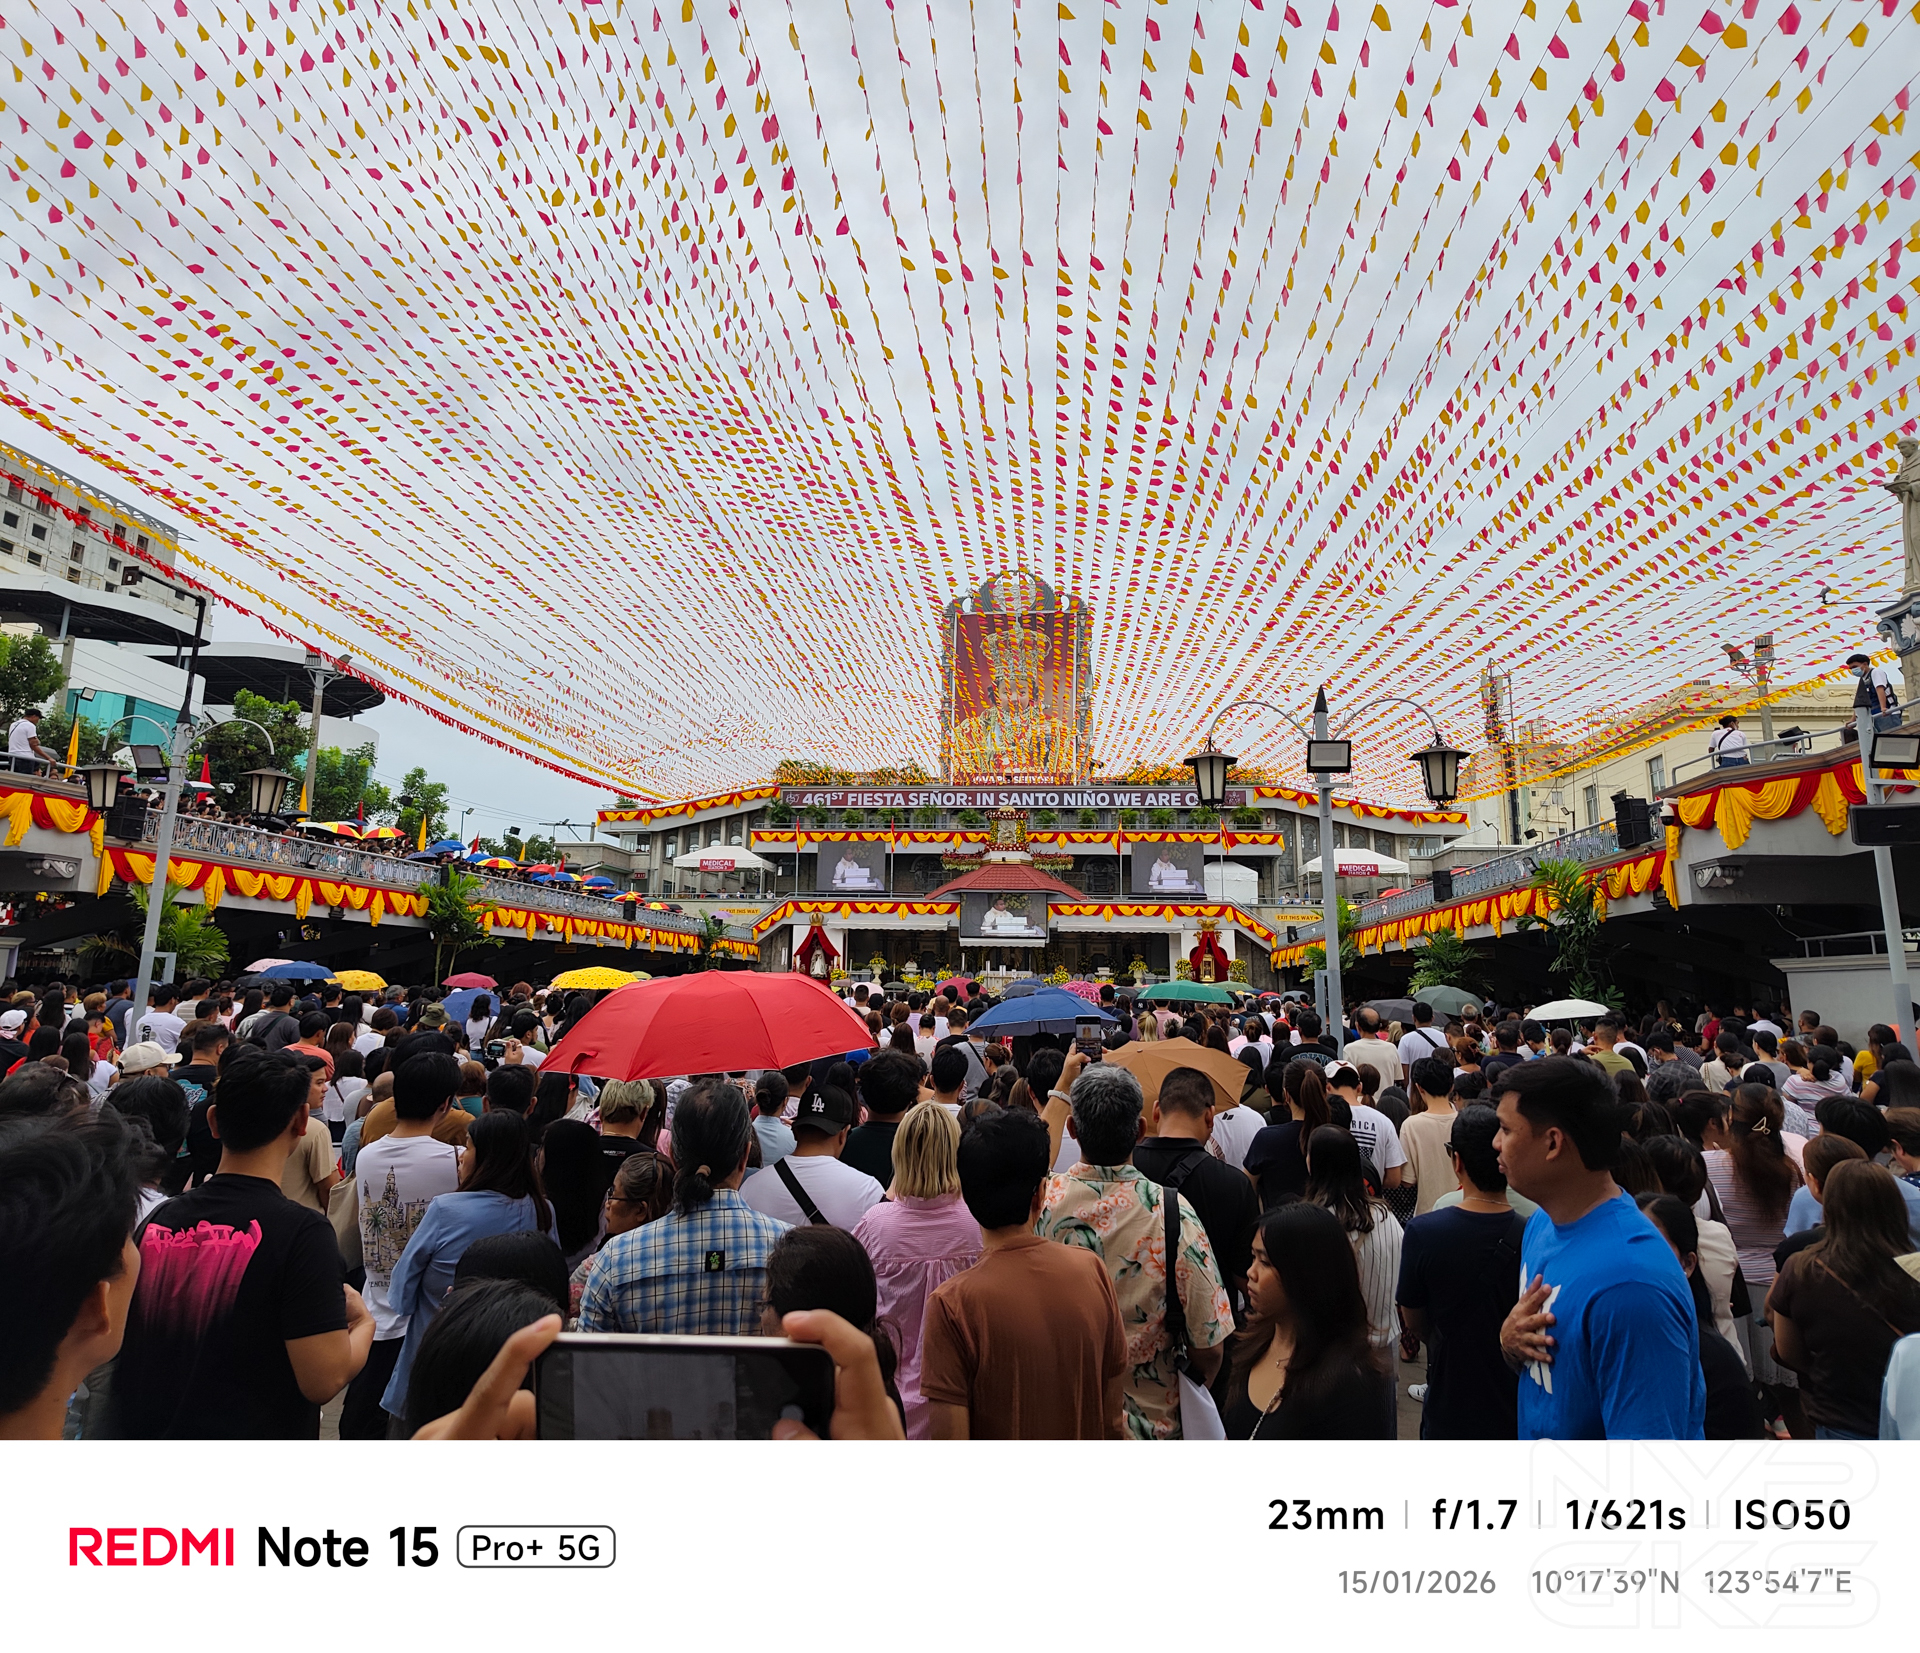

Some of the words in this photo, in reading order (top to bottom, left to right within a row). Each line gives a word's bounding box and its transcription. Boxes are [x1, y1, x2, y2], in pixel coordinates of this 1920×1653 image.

[803, 792, 845, 806] 461ST
[848, 793, 905, 806] FIESTA
[909, 790, 972, 806] SEÑOR:
[977, 793, 995, 806] IN
[999, 792, 1059, 806] SANTO
[1064, 790, 1109, 806] NIÑO
[1114, 793, 1141, 806] WE
[1145, 793, 1181, 806] ARE
[811, 1093, 825, 1113] LA
[1351, 1120, 1376, 1132] RICA
